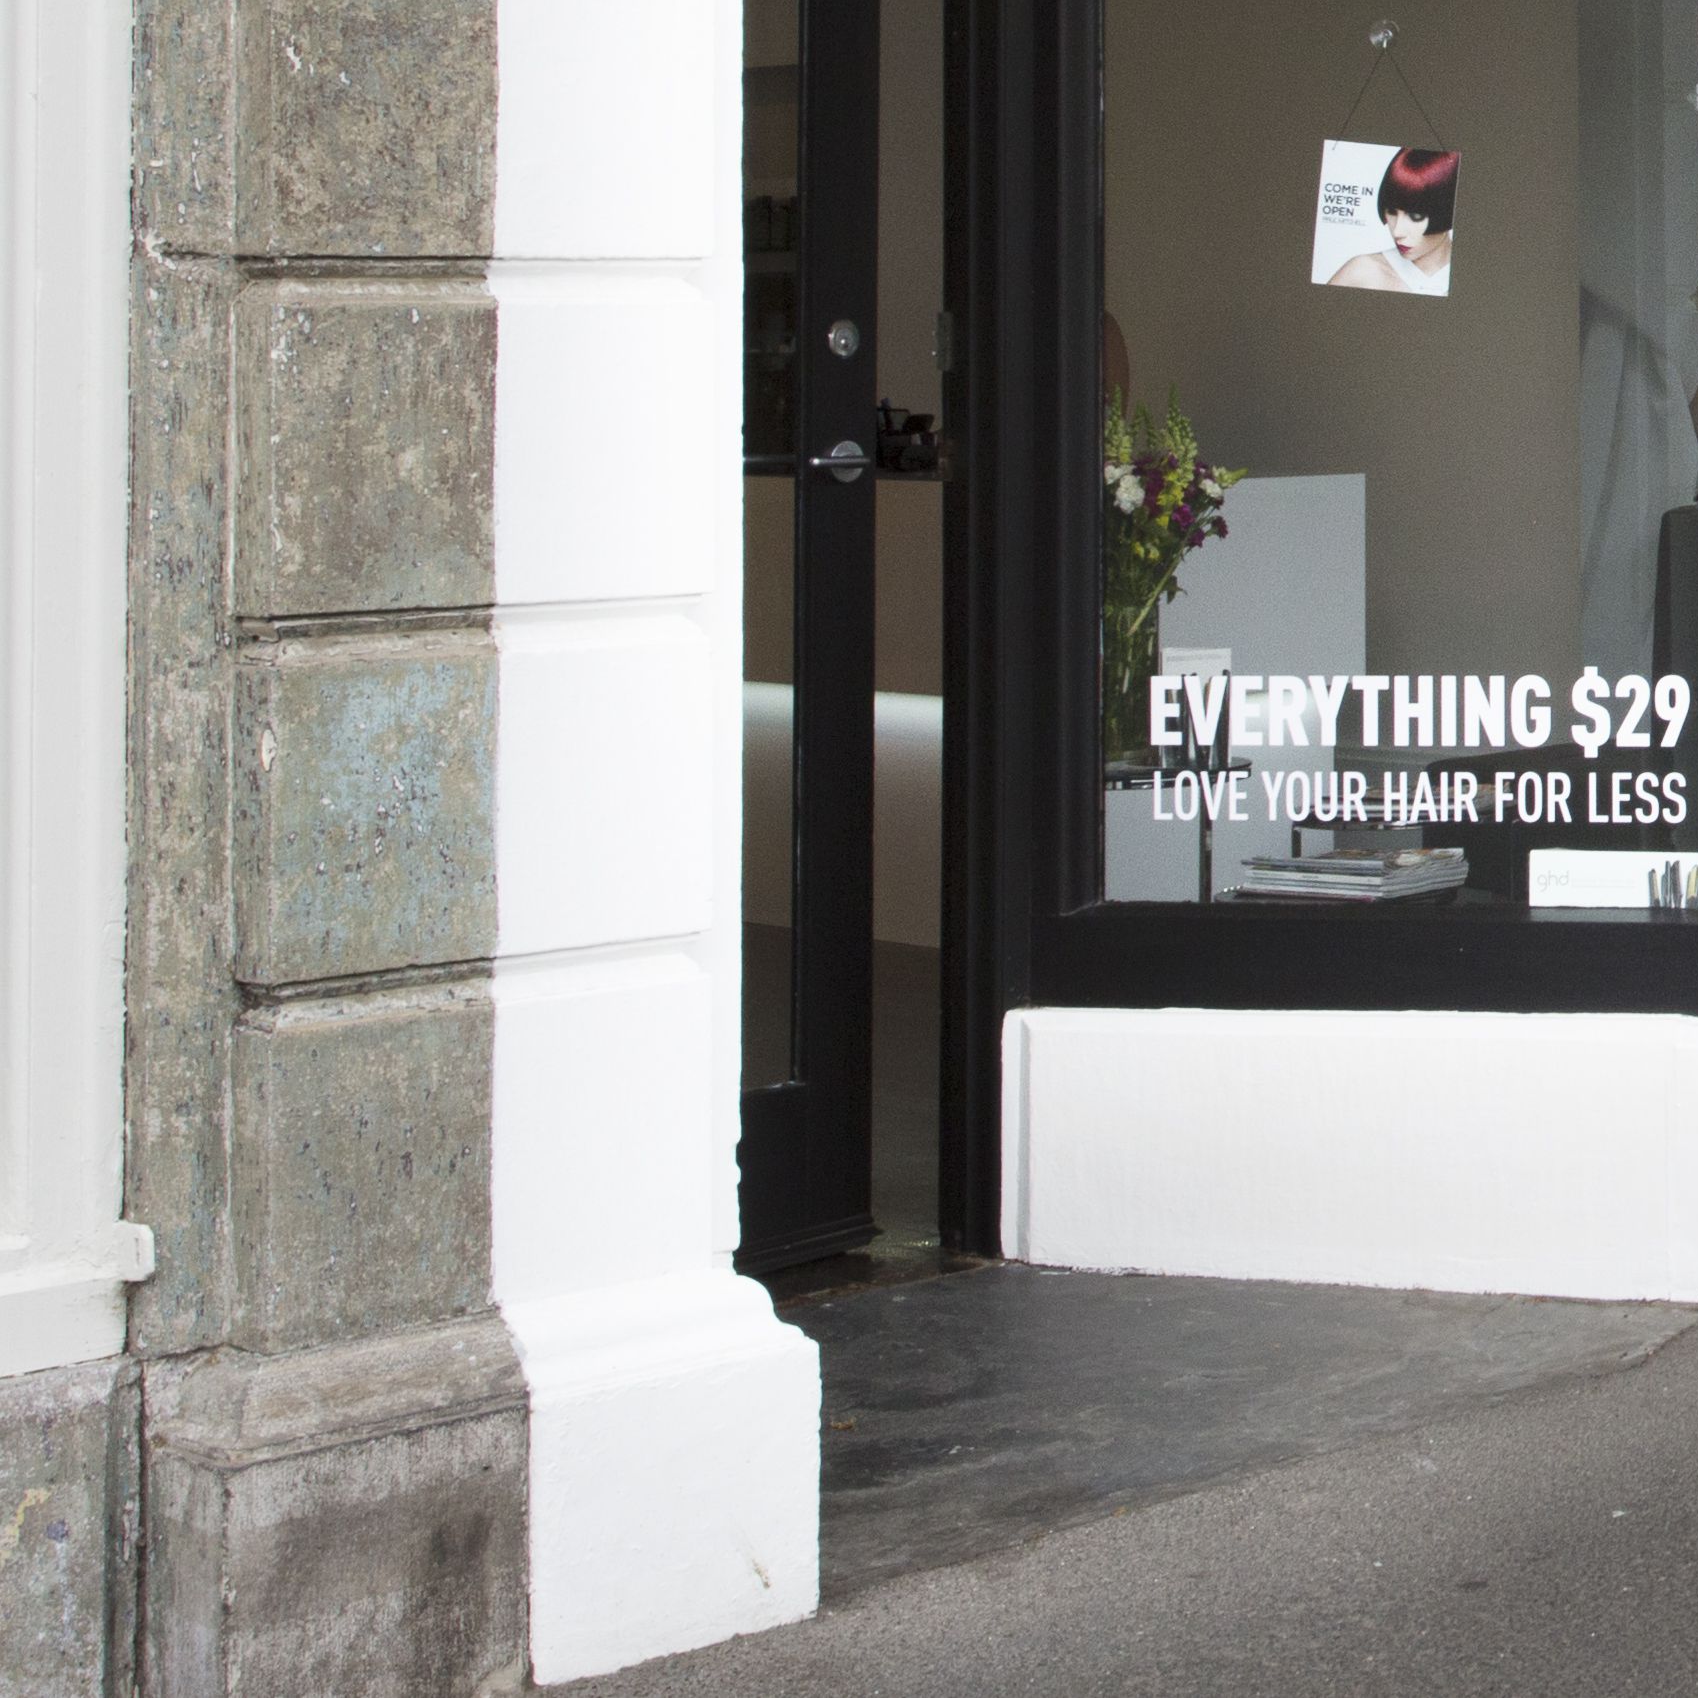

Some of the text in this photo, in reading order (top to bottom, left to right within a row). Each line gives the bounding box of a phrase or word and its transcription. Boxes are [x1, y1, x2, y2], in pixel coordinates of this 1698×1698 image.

[1324, 182, 1374, 197] COME IN
[1323, 194, 1362, 207] WE'RE
[1322, 205, 1354, 217] OPEN
[1149, 665, 1691, 758] EVERYTHING $29
[1152, 770, 1688, 825] LOVE YOUR HAIR FOR LESS
[1536, 869, 1570, 893] ghd
